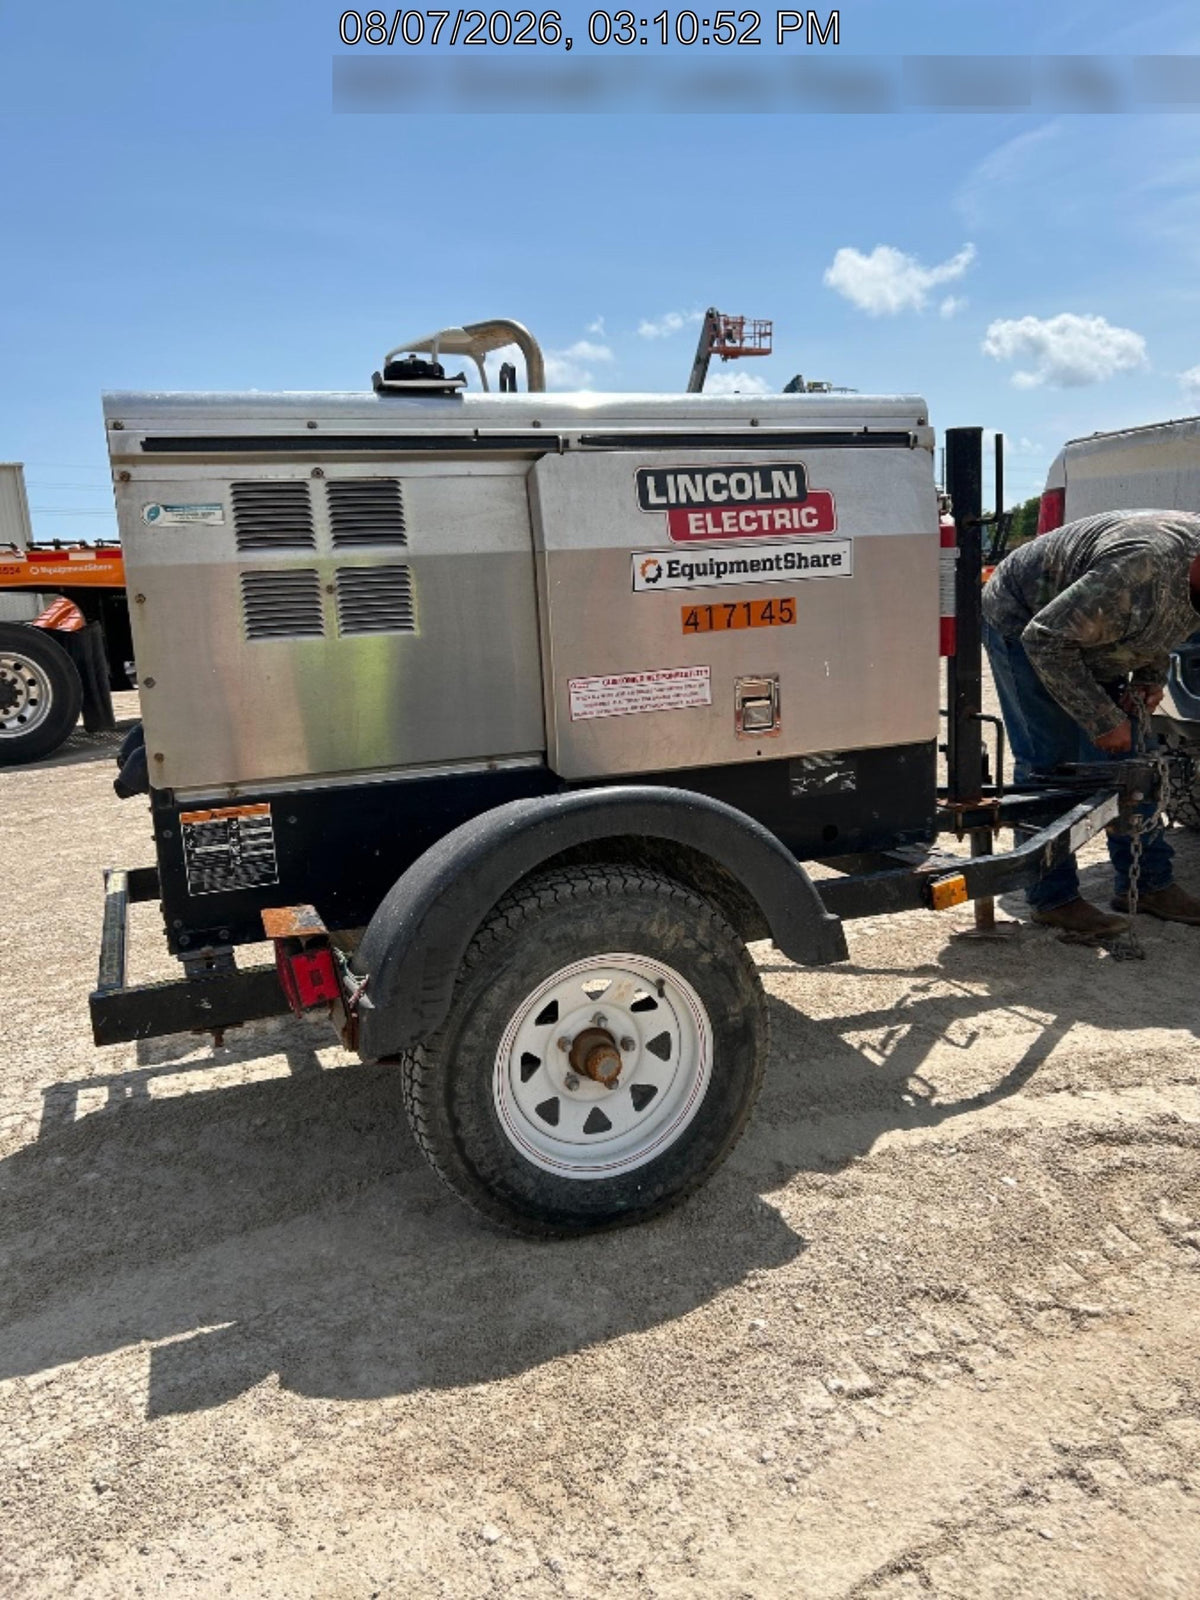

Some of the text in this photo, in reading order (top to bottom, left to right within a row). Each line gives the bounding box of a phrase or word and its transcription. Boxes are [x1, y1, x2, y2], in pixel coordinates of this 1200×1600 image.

[646, 470, 798, 504] LINCOLN
[687, 507, 819, 535] ELECTRIC
[666, 552, 843, 581] EquipmentShare
[684, 600, 793, 632] 417145
